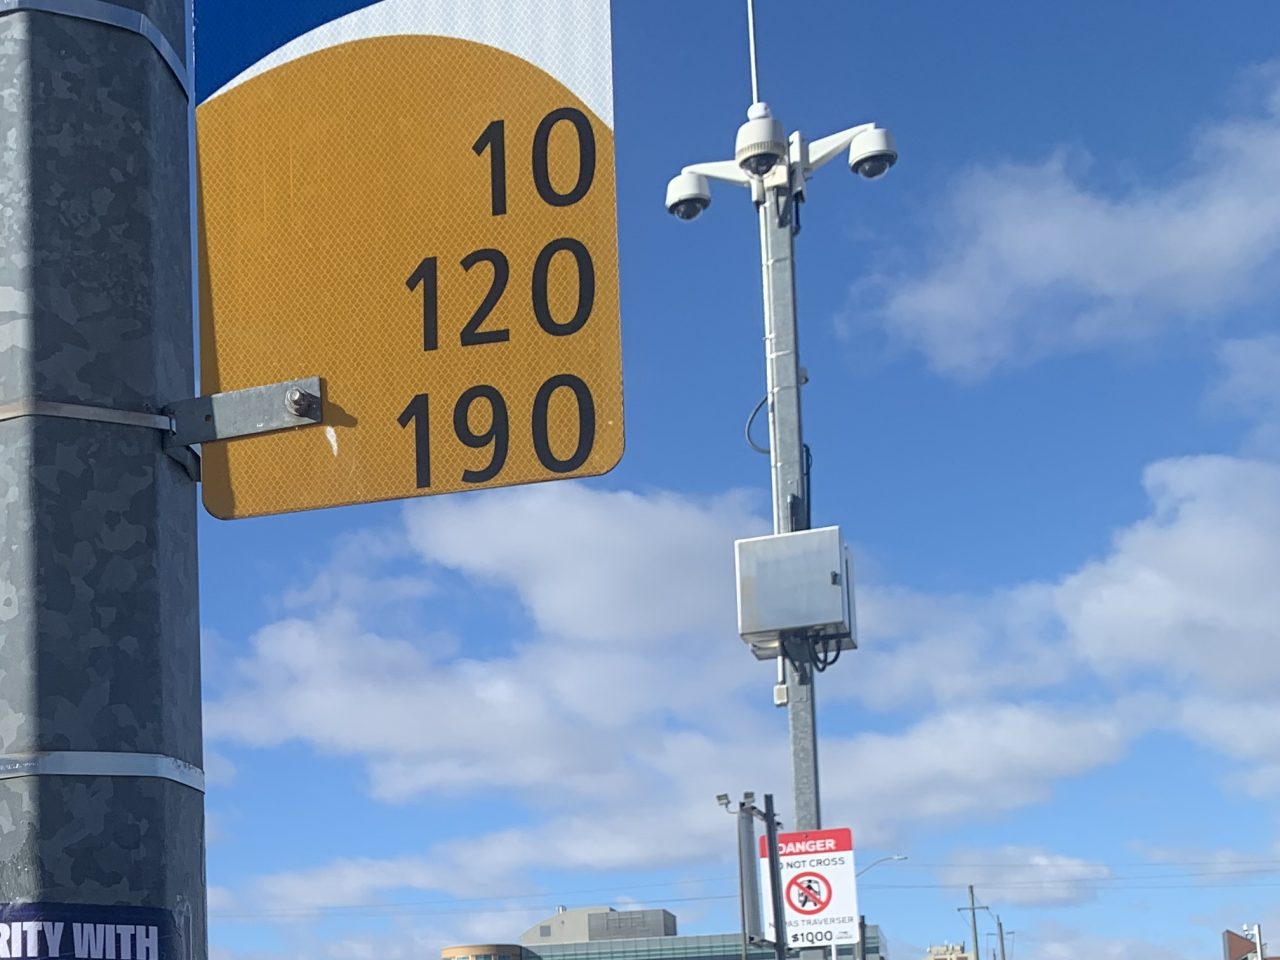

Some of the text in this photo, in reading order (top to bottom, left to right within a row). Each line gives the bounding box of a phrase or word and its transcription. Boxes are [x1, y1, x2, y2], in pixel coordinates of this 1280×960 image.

[471, 106, 597, 216] 10
[404, 237, 595, 352] 120
[396, 373, 597, 489] 190
[778, 838, 836, 854] DANGER
[786, 860, 807, 869] NOT
[809, 857, 845, 867] CROSS
[801, 916, 854, 926] TRAVERSER
[72, 922, 159, 960] WITH
[791, 930, 833, 943] $1000
